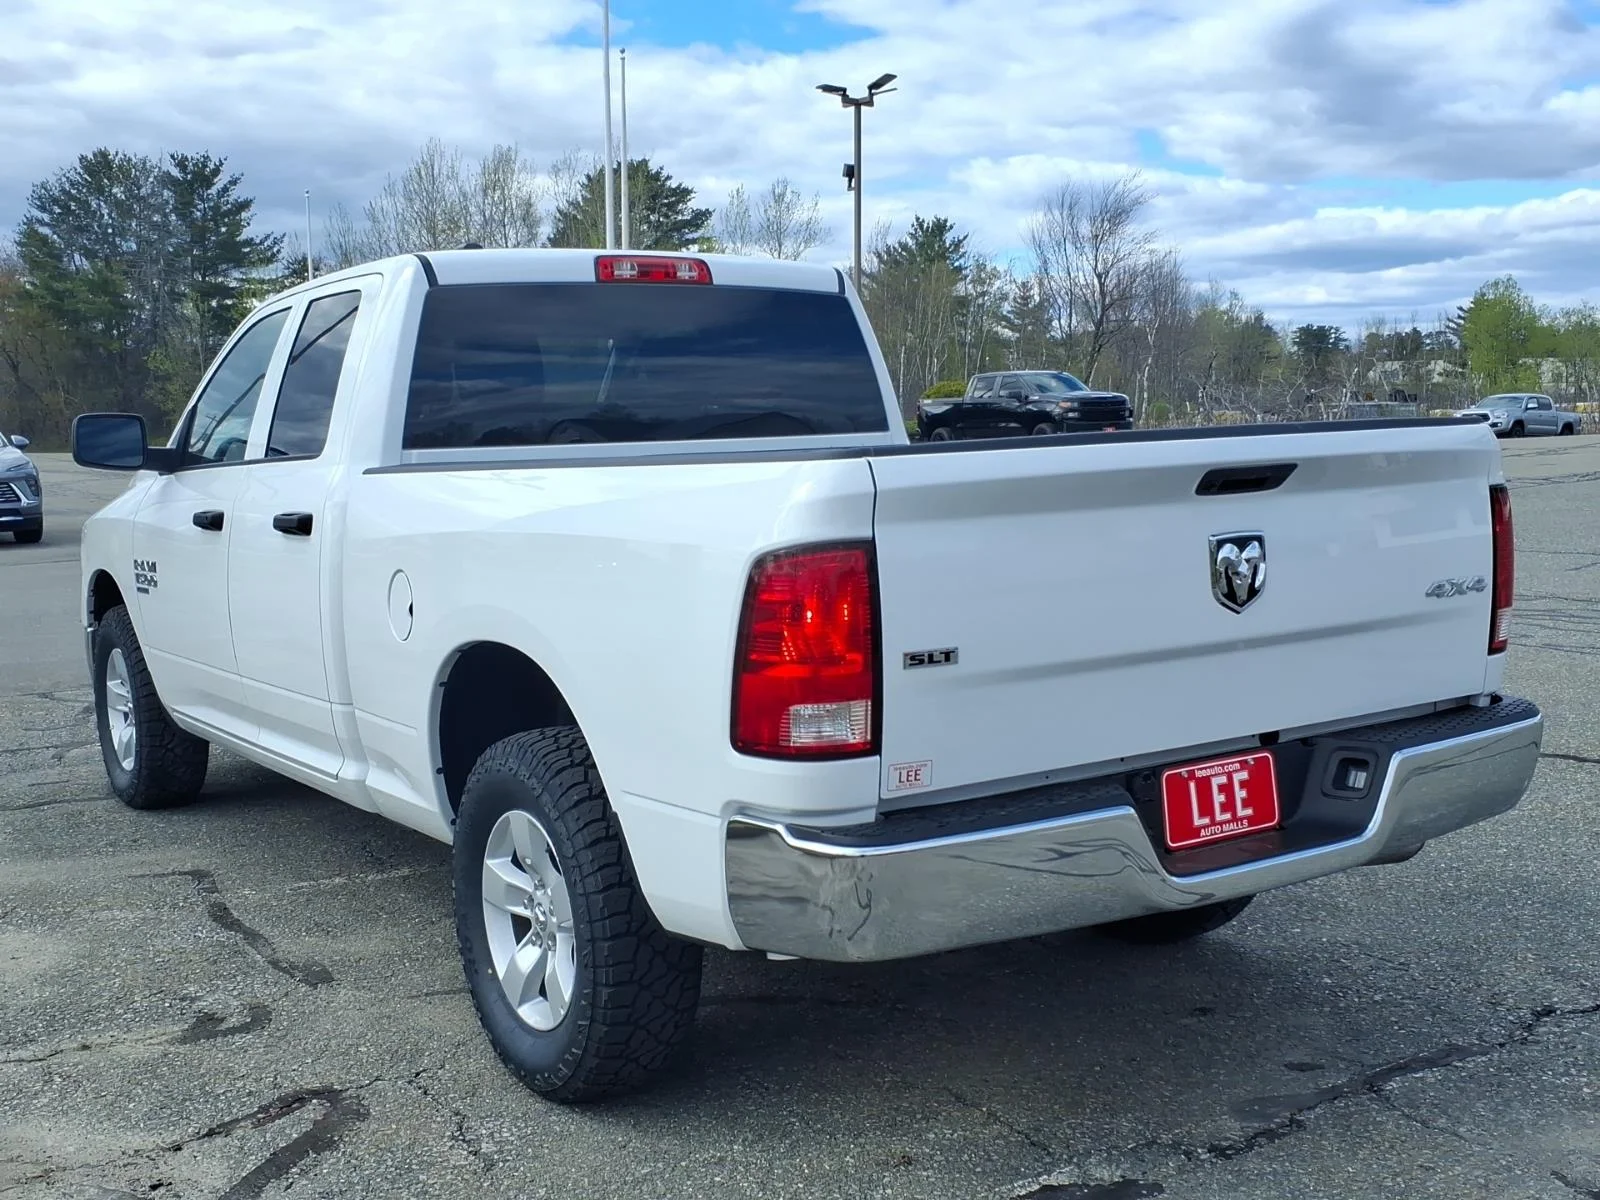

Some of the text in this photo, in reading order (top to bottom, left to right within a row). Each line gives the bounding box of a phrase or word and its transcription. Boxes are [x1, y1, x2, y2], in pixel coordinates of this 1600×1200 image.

[908, 650, 956, 667] SLT
[898, 768, 922, 784] LEE
[1195, 763, 1241, 778] leeauto.com
[1188, 769, 1254, 827] LEE
[1200, 819, 1249, 838] AUTO MALLS
